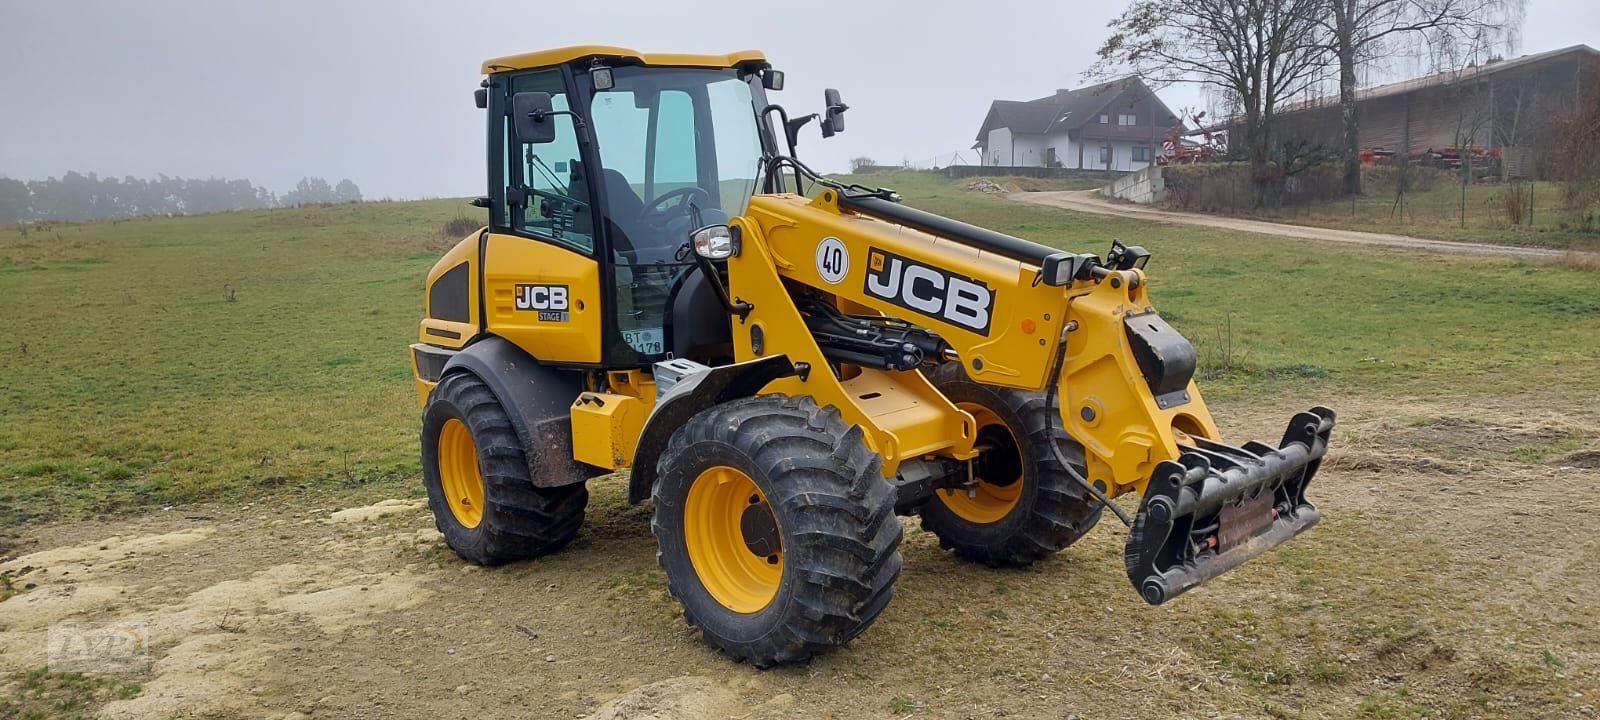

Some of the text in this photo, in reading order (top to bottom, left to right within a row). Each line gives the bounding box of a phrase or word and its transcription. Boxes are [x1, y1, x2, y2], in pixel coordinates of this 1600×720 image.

[822, 246, 842, 275] 40
[516, 286, 568, 310] JCB
[867, 258, 991, 330] JCB
[539, 312, 560, 321] STAGE
[625, 332, 640, 343] BT
